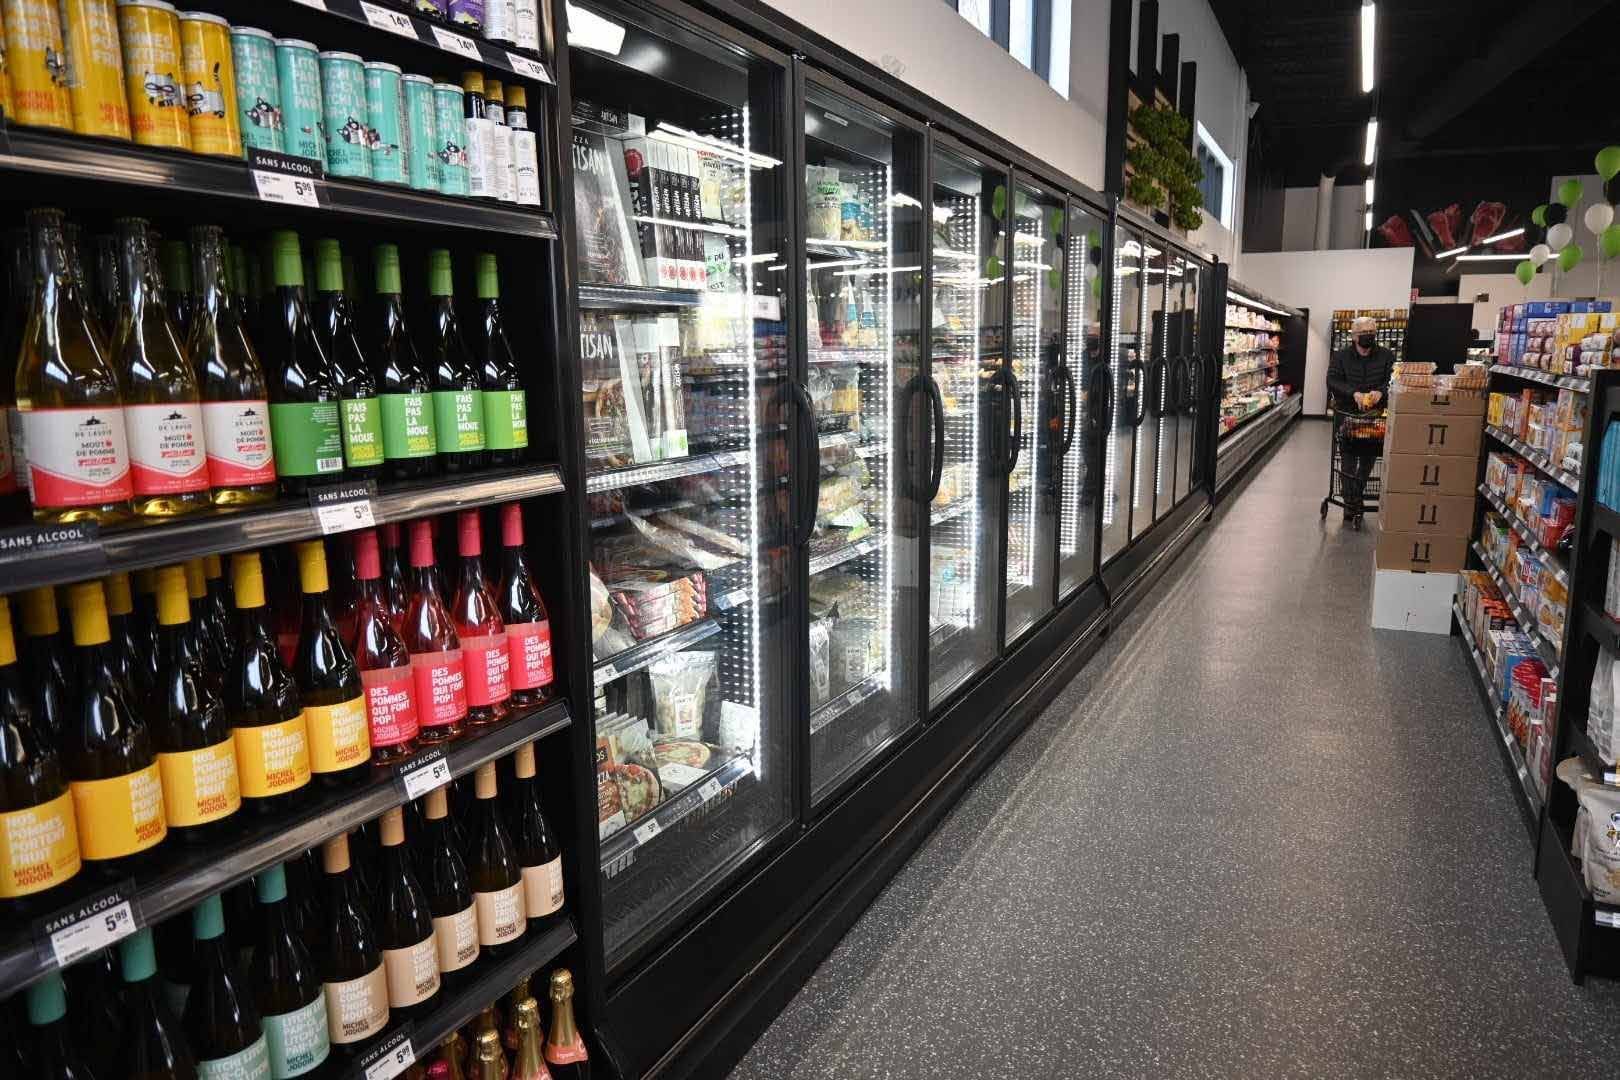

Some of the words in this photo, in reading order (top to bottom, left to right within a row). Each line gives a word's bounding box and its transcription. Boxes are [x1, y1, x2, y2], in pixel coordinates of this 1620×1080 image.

[256, 156, 279, 168] SANS
[281, 161, 313, 174] ALCOOL
[404, 397, 423, 407] FAIS
[456, 394, 473, 403] FAIS
[346, 402, 367, 413] FAIS
[405, 407, 422, 416] PAS
[456, 403, 472, 413] PAS
[348, 413, 366, 423] PAS
[457, 413, 468, 422] LA
[512, 411, 520, 419] LA
[406, 417, 418, 426] LA
[457, 421, 480, 431] MOUE
[349, 423, 362, 433] LA
[406, 425, 429, 436] MOUE
[350, 432, 375, 443] MOUE
[318, 492, 338, 502] SANS
[340, 487, 369, 499] ALCOOL
[0, 537, 33, 549] SANS
[37, 528, 84, 543] ALCOOL
[525, 636, 539, 646] DES
[486, 649, 500, 658] DES
[526, 652, 539, 662] QUI
[431, 667, 448, 676] DES
[487, 667, 500, 676] QUI
[432, 672, 463, 686] POMMES
[370, 686, 389, 697] DES
[433, 685, 449, 695] QUI
[449, 680, 464, 692] FONT
[371, 691, 408, 706] POMMES
[372, 706, 388, 716] QUI
[391, 699, 410, 712] FONT
[336, 745, 360, 757] MICHEL
[338, 752, 361, 762] JODOIN
[399, 763, 417, 774] SANS
[417, 750, 441, 766] ALCOOL
[266, 769, 293, 781] MICHEL
[268, 775, 295, 788] JODOIN
[197, 795, 226, 808] MICHEL
[199, 801, 228, 816] JODOIN
[135, 821, 161, 835] MICHEL
[137, 826, 162, 843] JODOIN
[14, 863, 51, 878] MICHEL
[16, 870, 54, 887] JODOIN
[45, 914, 77, 934] SANS
[79, 893, 122, 918] ALCOOL
[342, 1019, 369, 1031] MICHEL
[344, 1024, 369, 1037] JODOIN
[360, 1051, 379, 1066] SANS
[380, 1034, 405, 1053] ALCOOL
[287, 1051, 313, 1065] MICHEL
[288, 1056, 314, 1072] JODOIN
